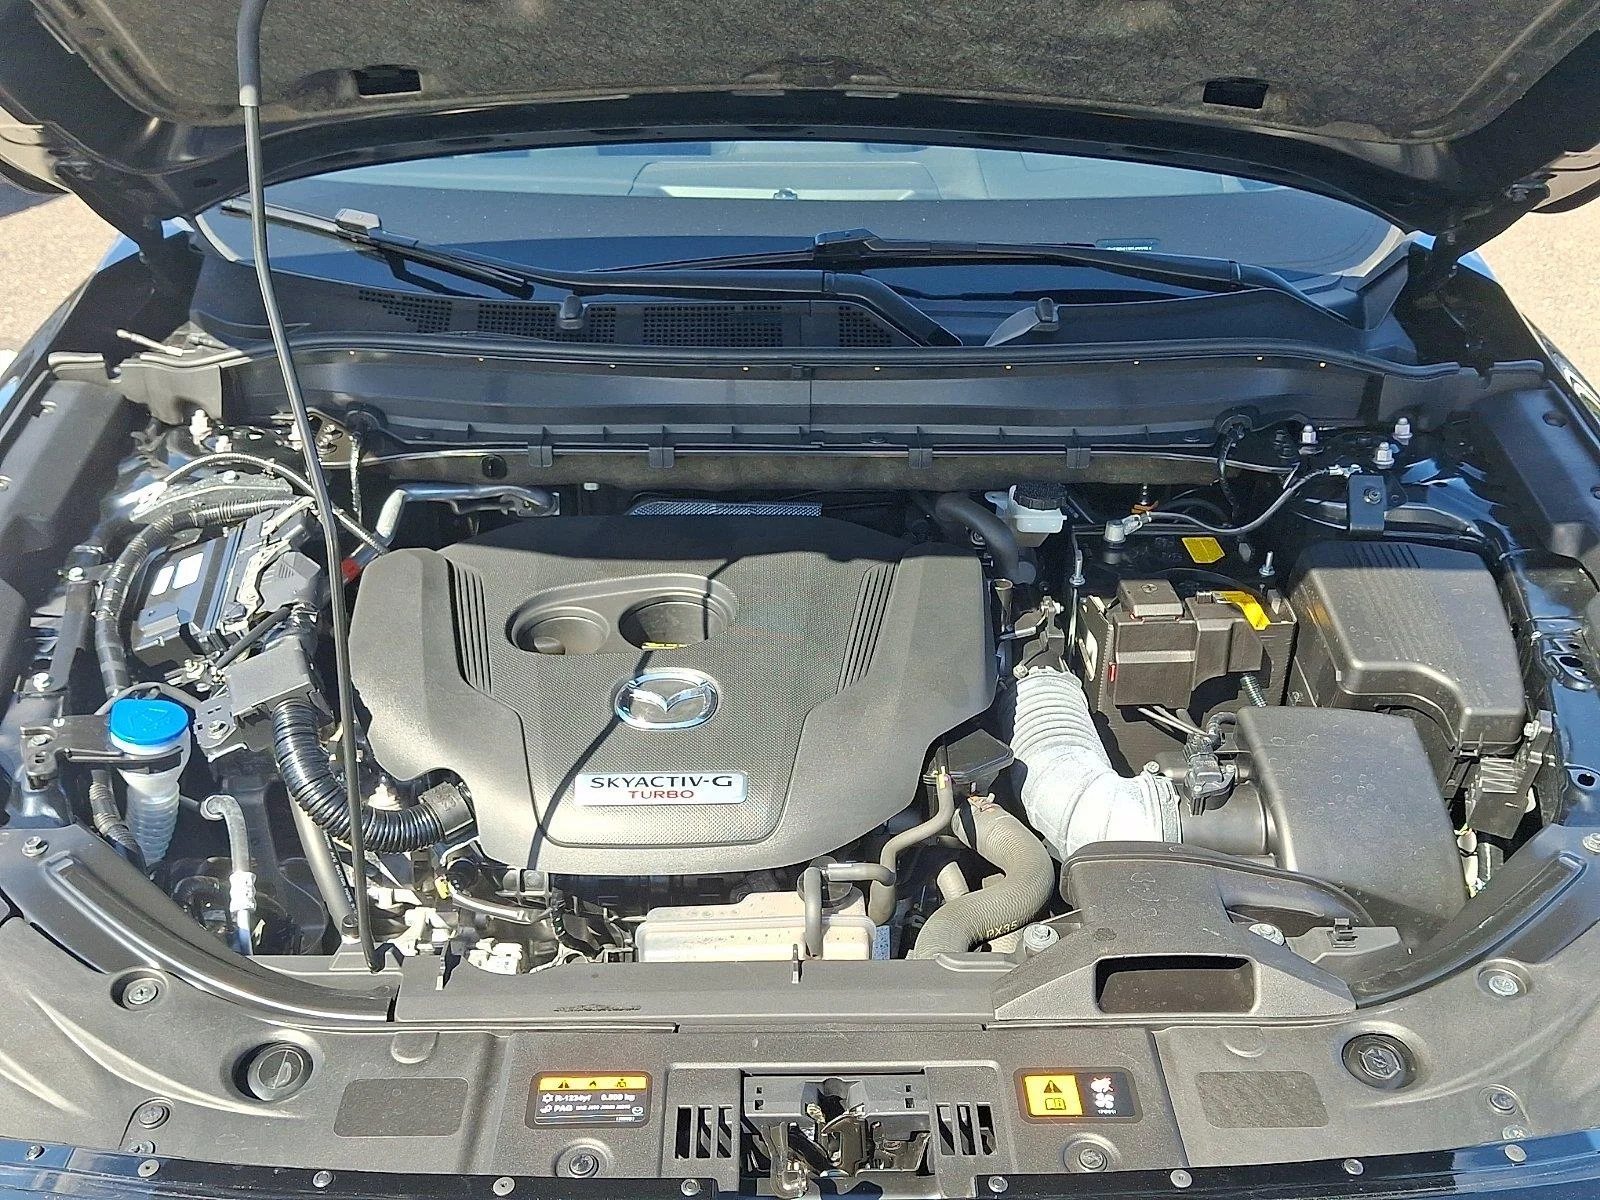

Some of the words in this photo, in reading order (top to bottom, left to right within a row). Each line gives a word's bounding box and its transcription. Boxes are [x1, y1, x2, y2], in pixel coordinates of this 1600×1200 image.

[590, 775, 733, 788] SKYACTIV-G
[628, 790, 694, 799] TURBO
[553, 1104, 573, 1112] PAG
